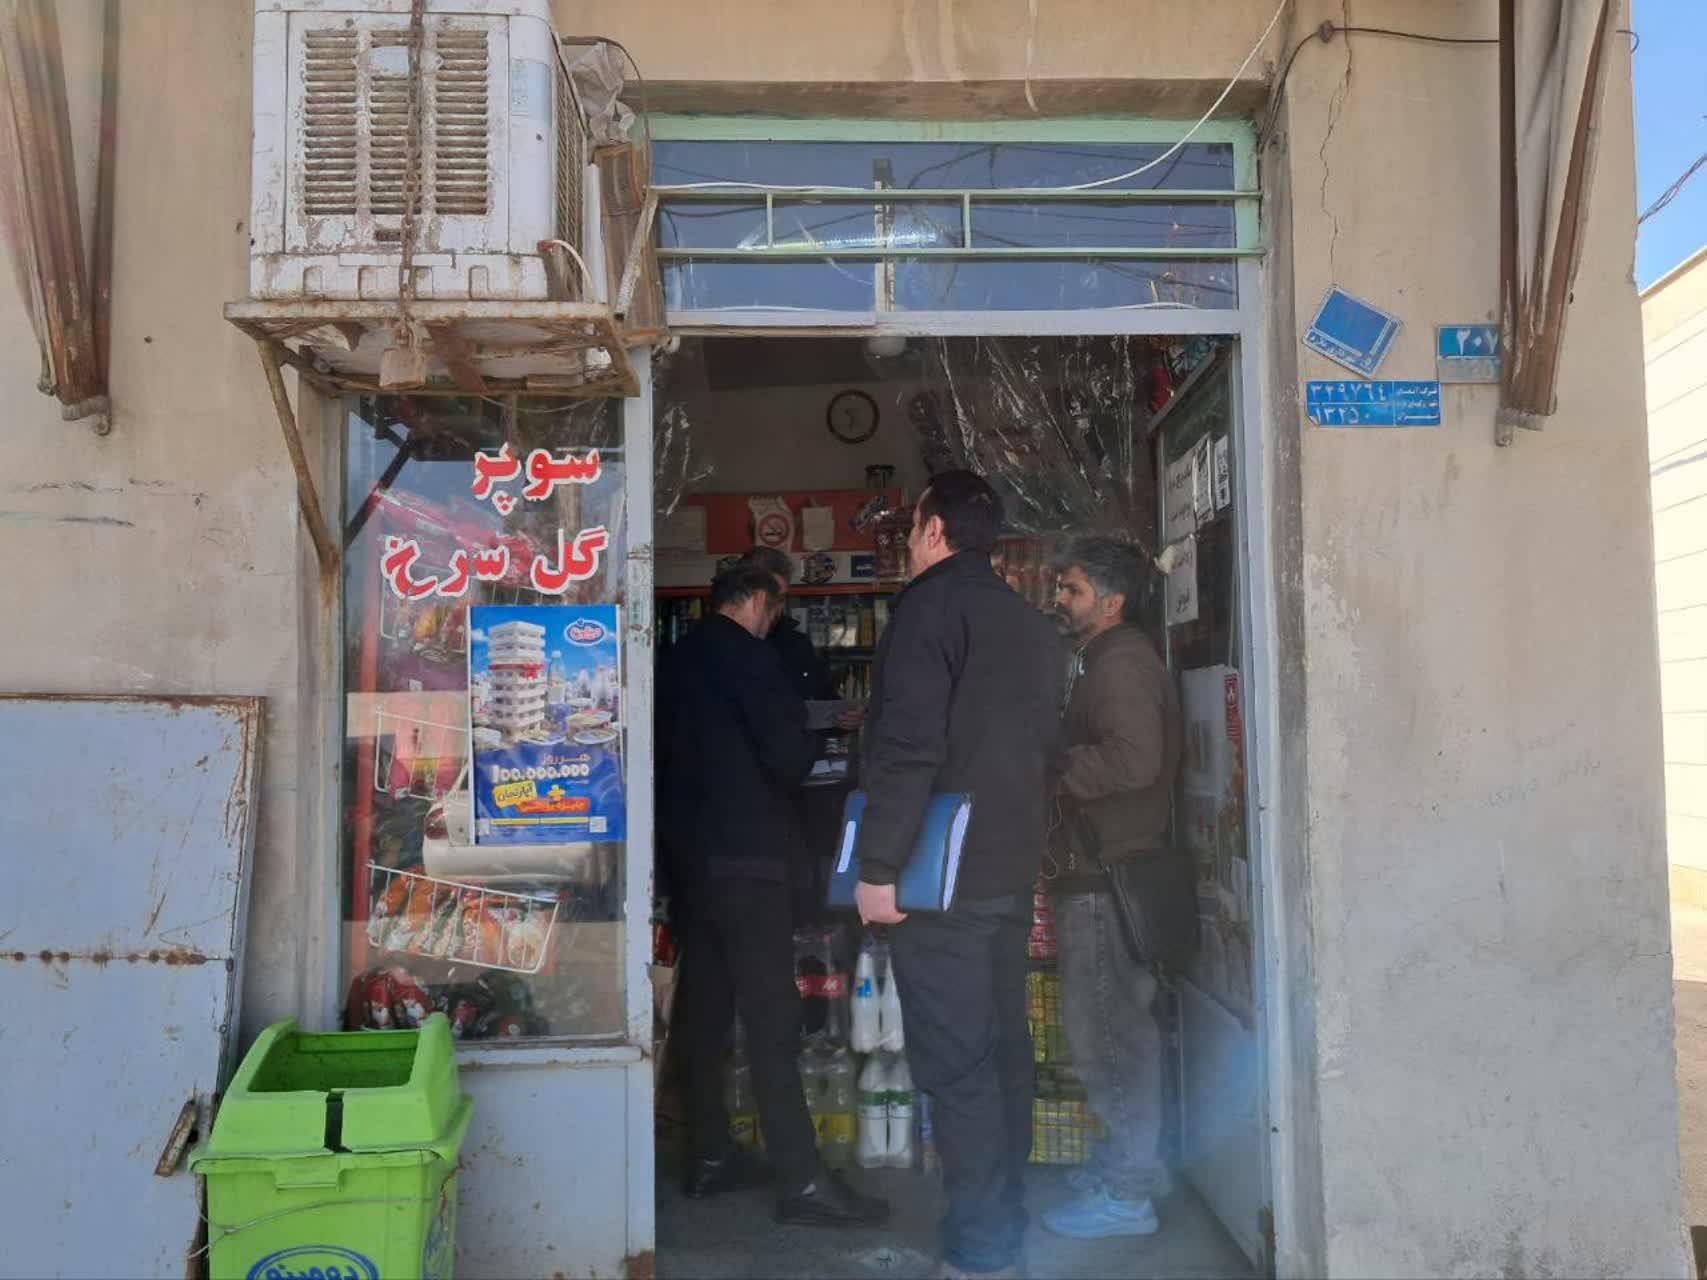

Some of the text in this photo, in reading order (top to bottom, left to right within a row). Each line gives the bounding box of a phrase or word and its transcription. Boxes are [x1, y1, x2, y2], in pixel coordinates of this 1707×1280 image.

[471, 441, 602, 515] سوپر
[380, 525, 609, 600] گل سرخ
